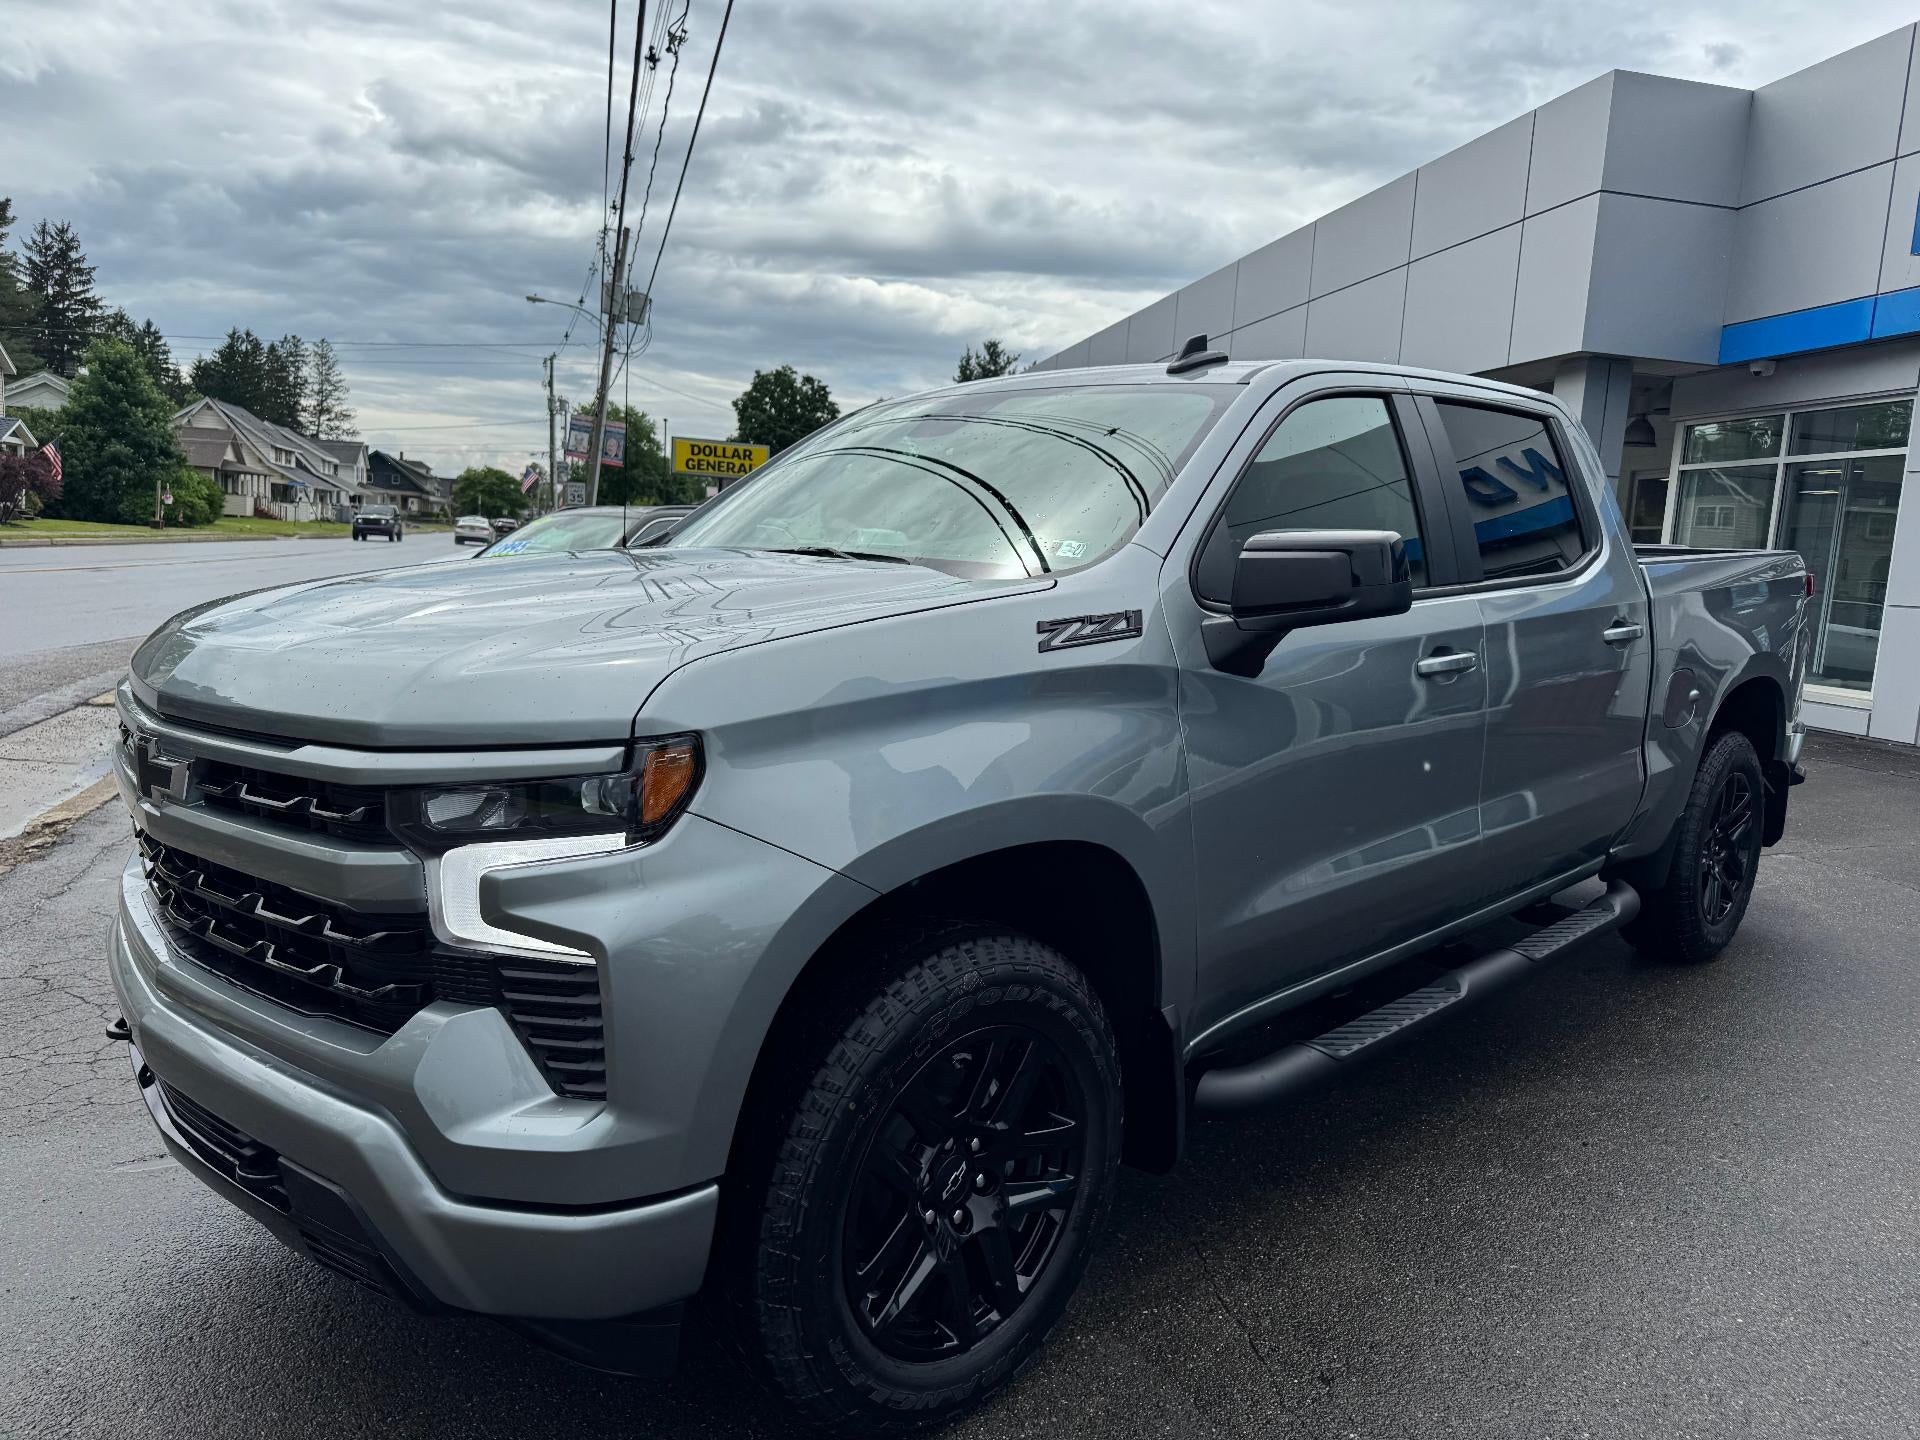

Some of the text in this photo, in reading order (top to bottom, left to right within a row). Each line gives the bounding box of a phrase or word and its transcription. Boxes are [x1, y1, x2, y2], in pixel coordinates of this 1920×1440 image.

[690, 444, 753, 461] DOLLAR
[569, 493, 584, 503] 35
[1036, 609, 1142, 653] Z71
